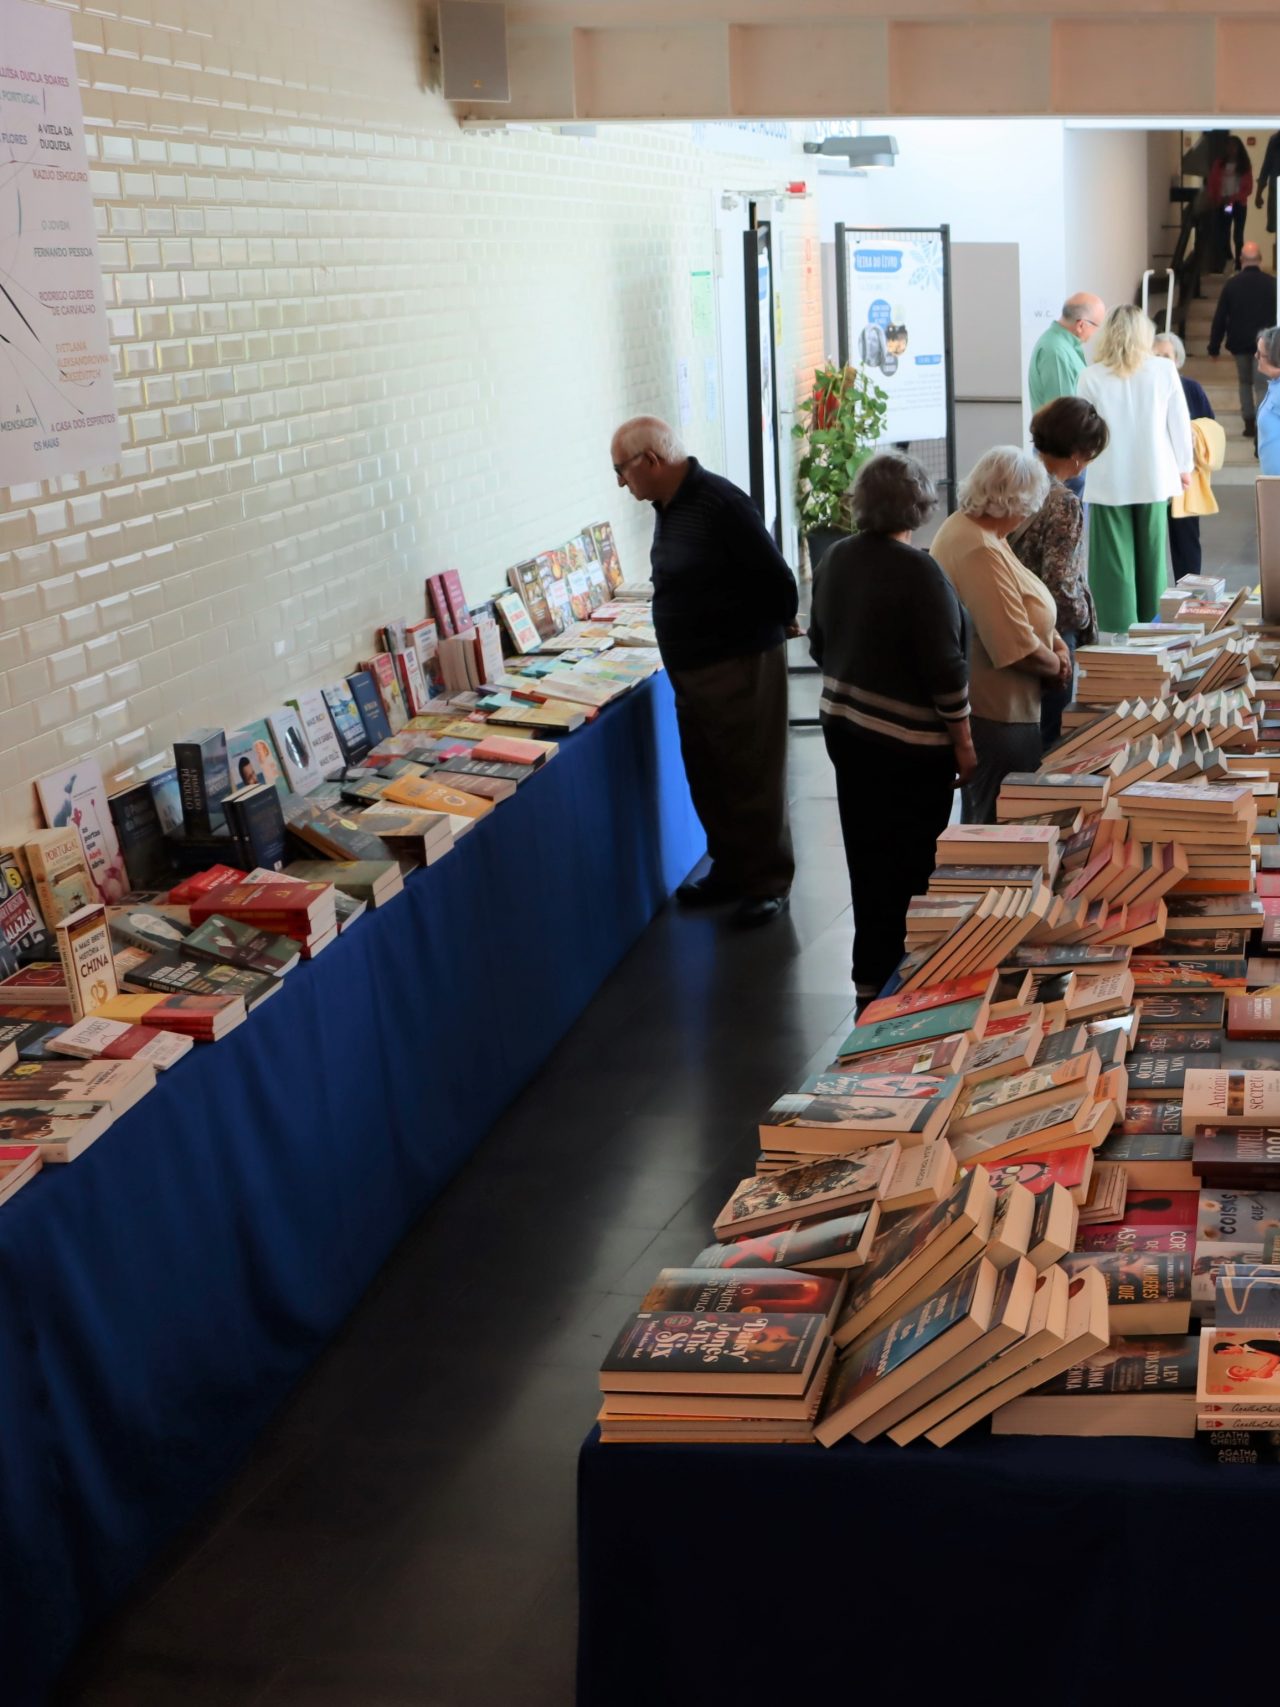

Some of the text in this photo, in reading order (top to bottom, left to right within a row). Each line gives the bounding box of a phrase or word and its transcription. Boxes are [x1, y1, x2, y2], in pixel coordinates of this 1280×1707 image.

[44, 74, 69, 87] SOARES
[2, 133, 28, 145] FLORES
[40, 139, 72, 151] DUQUESA
[33, 247, 94, 257] FERNANDO PESSOA
[68, 289, 94, 300] GUEDES
[62, 304, 96, 316] CARVALHO
[0, 417, 38, 432] MENSAGEM
[80, 953, 110, 978] CHINA
[1236, 1128, 1263, 1160] ORWELL
[1219, 1193, 1238, 1235] COISAS
[1250, 1202, 1266, 1222] QUE
[1115, 1227, 1137, 1254] ASAS
[1144, 1240, 1159, 1250] DE
[1168, 1231, 1187, 1252] COR
[1142, 1263, 1160, 1299] MULHERES
[1117, 1284, 1134, 1301] QUE
[650, 1330, 689, 1360] Six
[683, 1332, 707, 1355] The
[700, 1322, 741, 1363] Jones
[722, 1317, 769, 1364] Daisy
[1085, 1364, 1104, 1388] ANNA
[1143, 1350, 1160, 1386] TOLSTÓI
[1171, 1364, 1180, 1386] LEV
[1210, 1431, 1250, 1439] AGATHA
[1217, 1449, 1258, 1457] AGATHA
[1217, 1456, 1258, 1464] CHRISTIE
